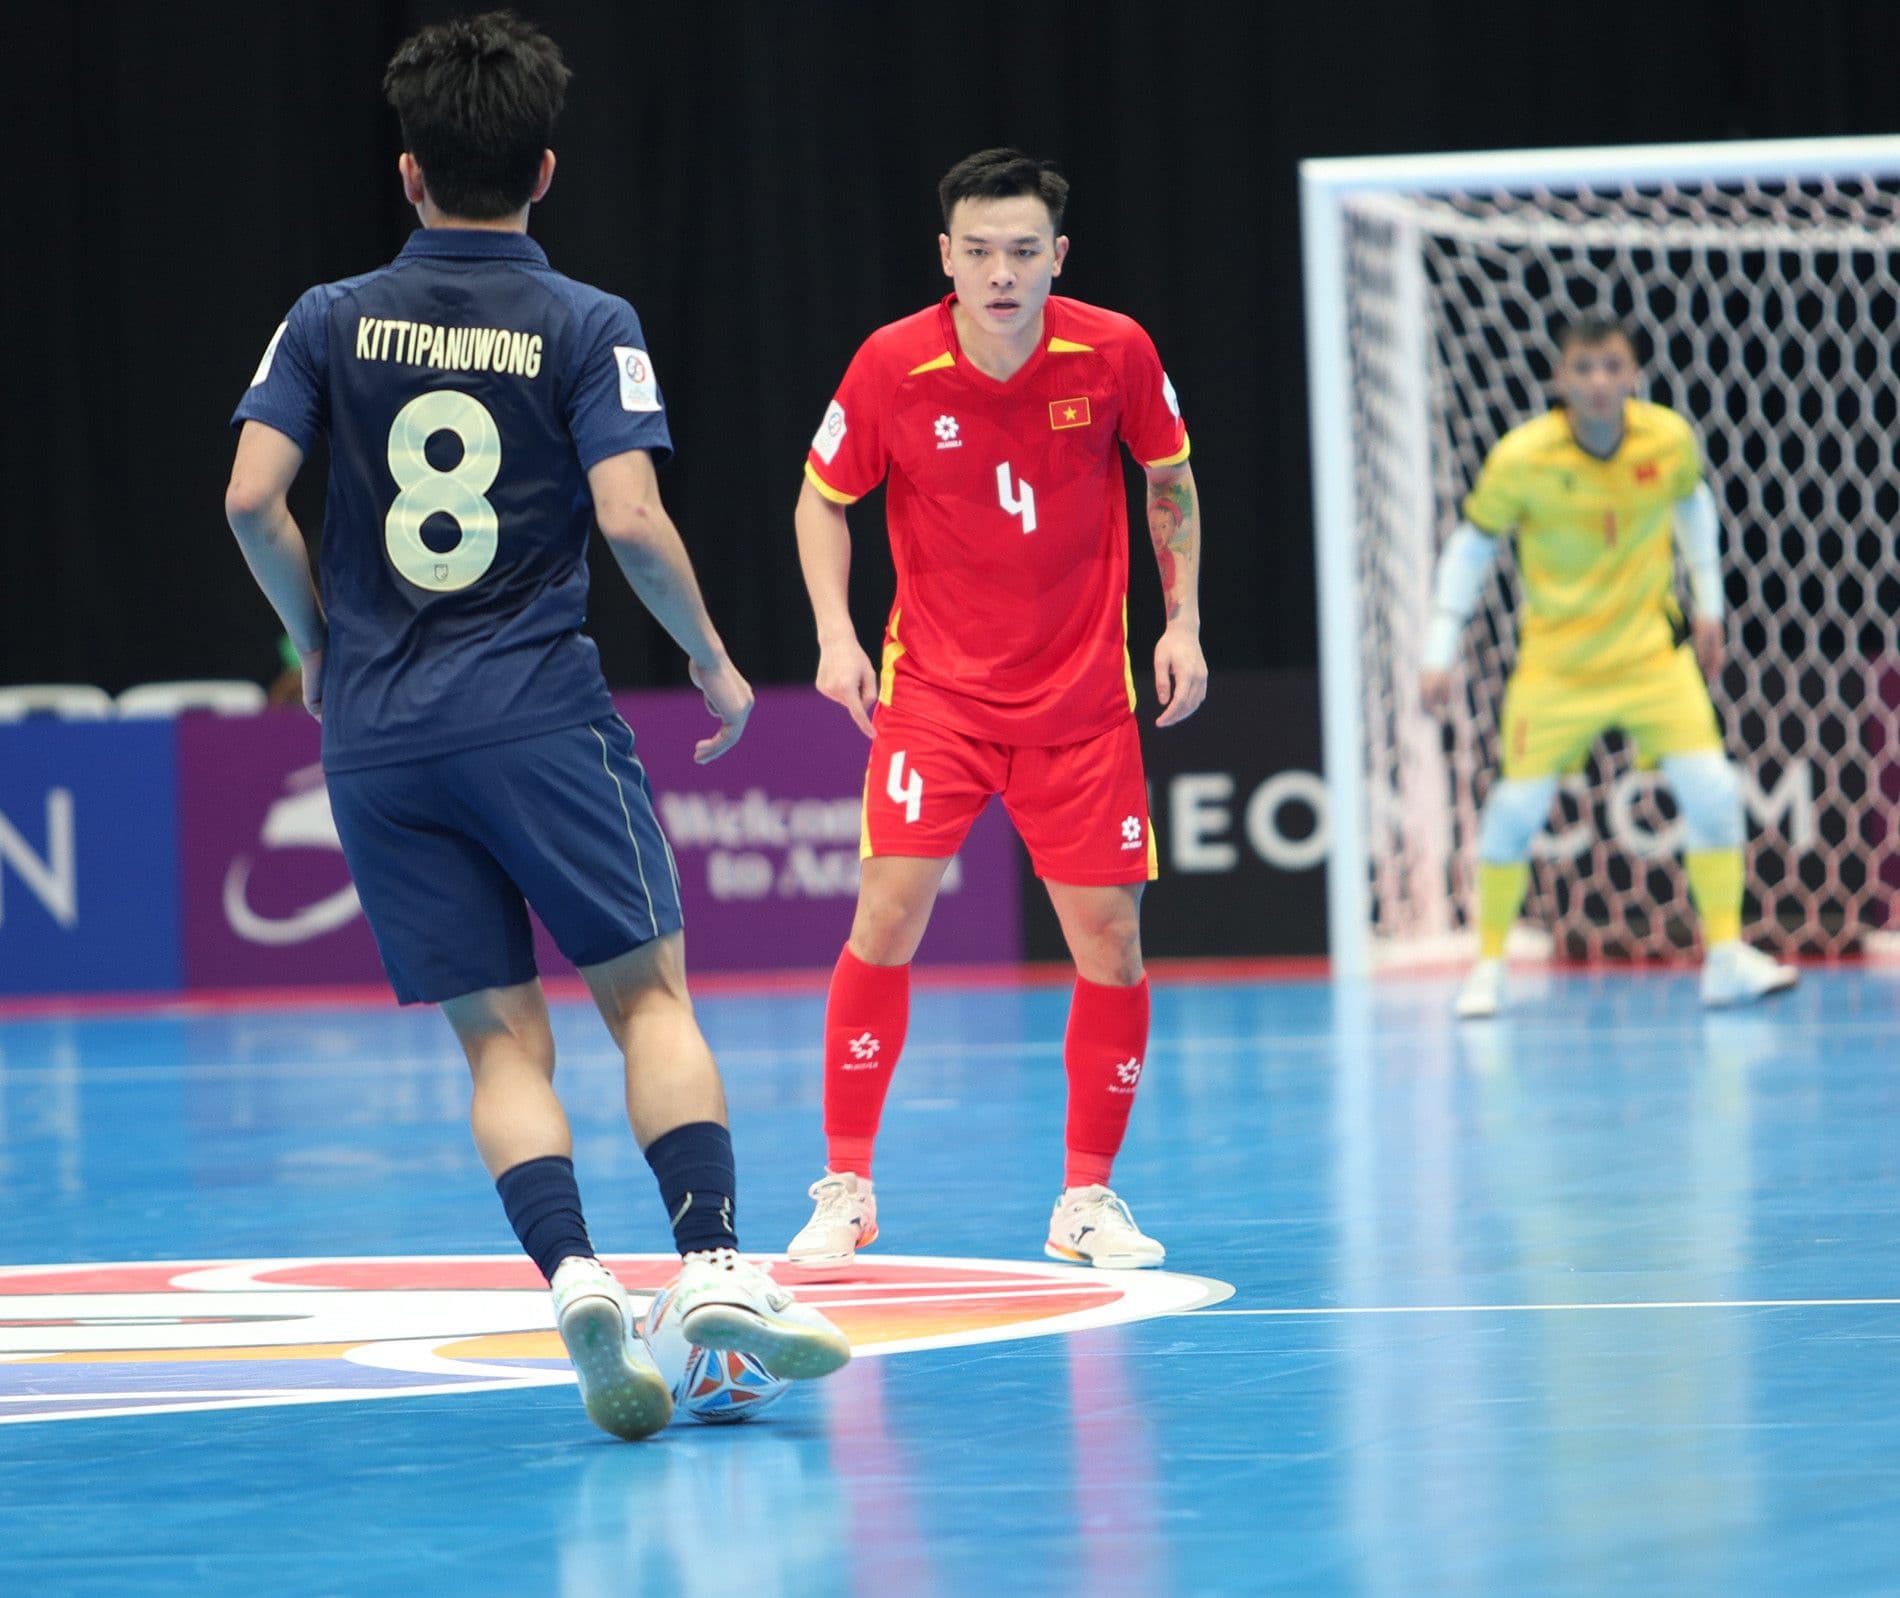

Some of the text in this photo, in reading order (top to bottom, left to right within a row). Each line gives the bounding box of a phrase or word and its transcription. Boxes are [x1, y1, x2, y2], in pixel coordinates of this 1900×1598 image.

[356, 317, 543, 379] KITTIPANUWONG
[385, 389, 501, 592] 8
[995, 461, 1037, 535] 4
[886, 750, 924, 824] 4
